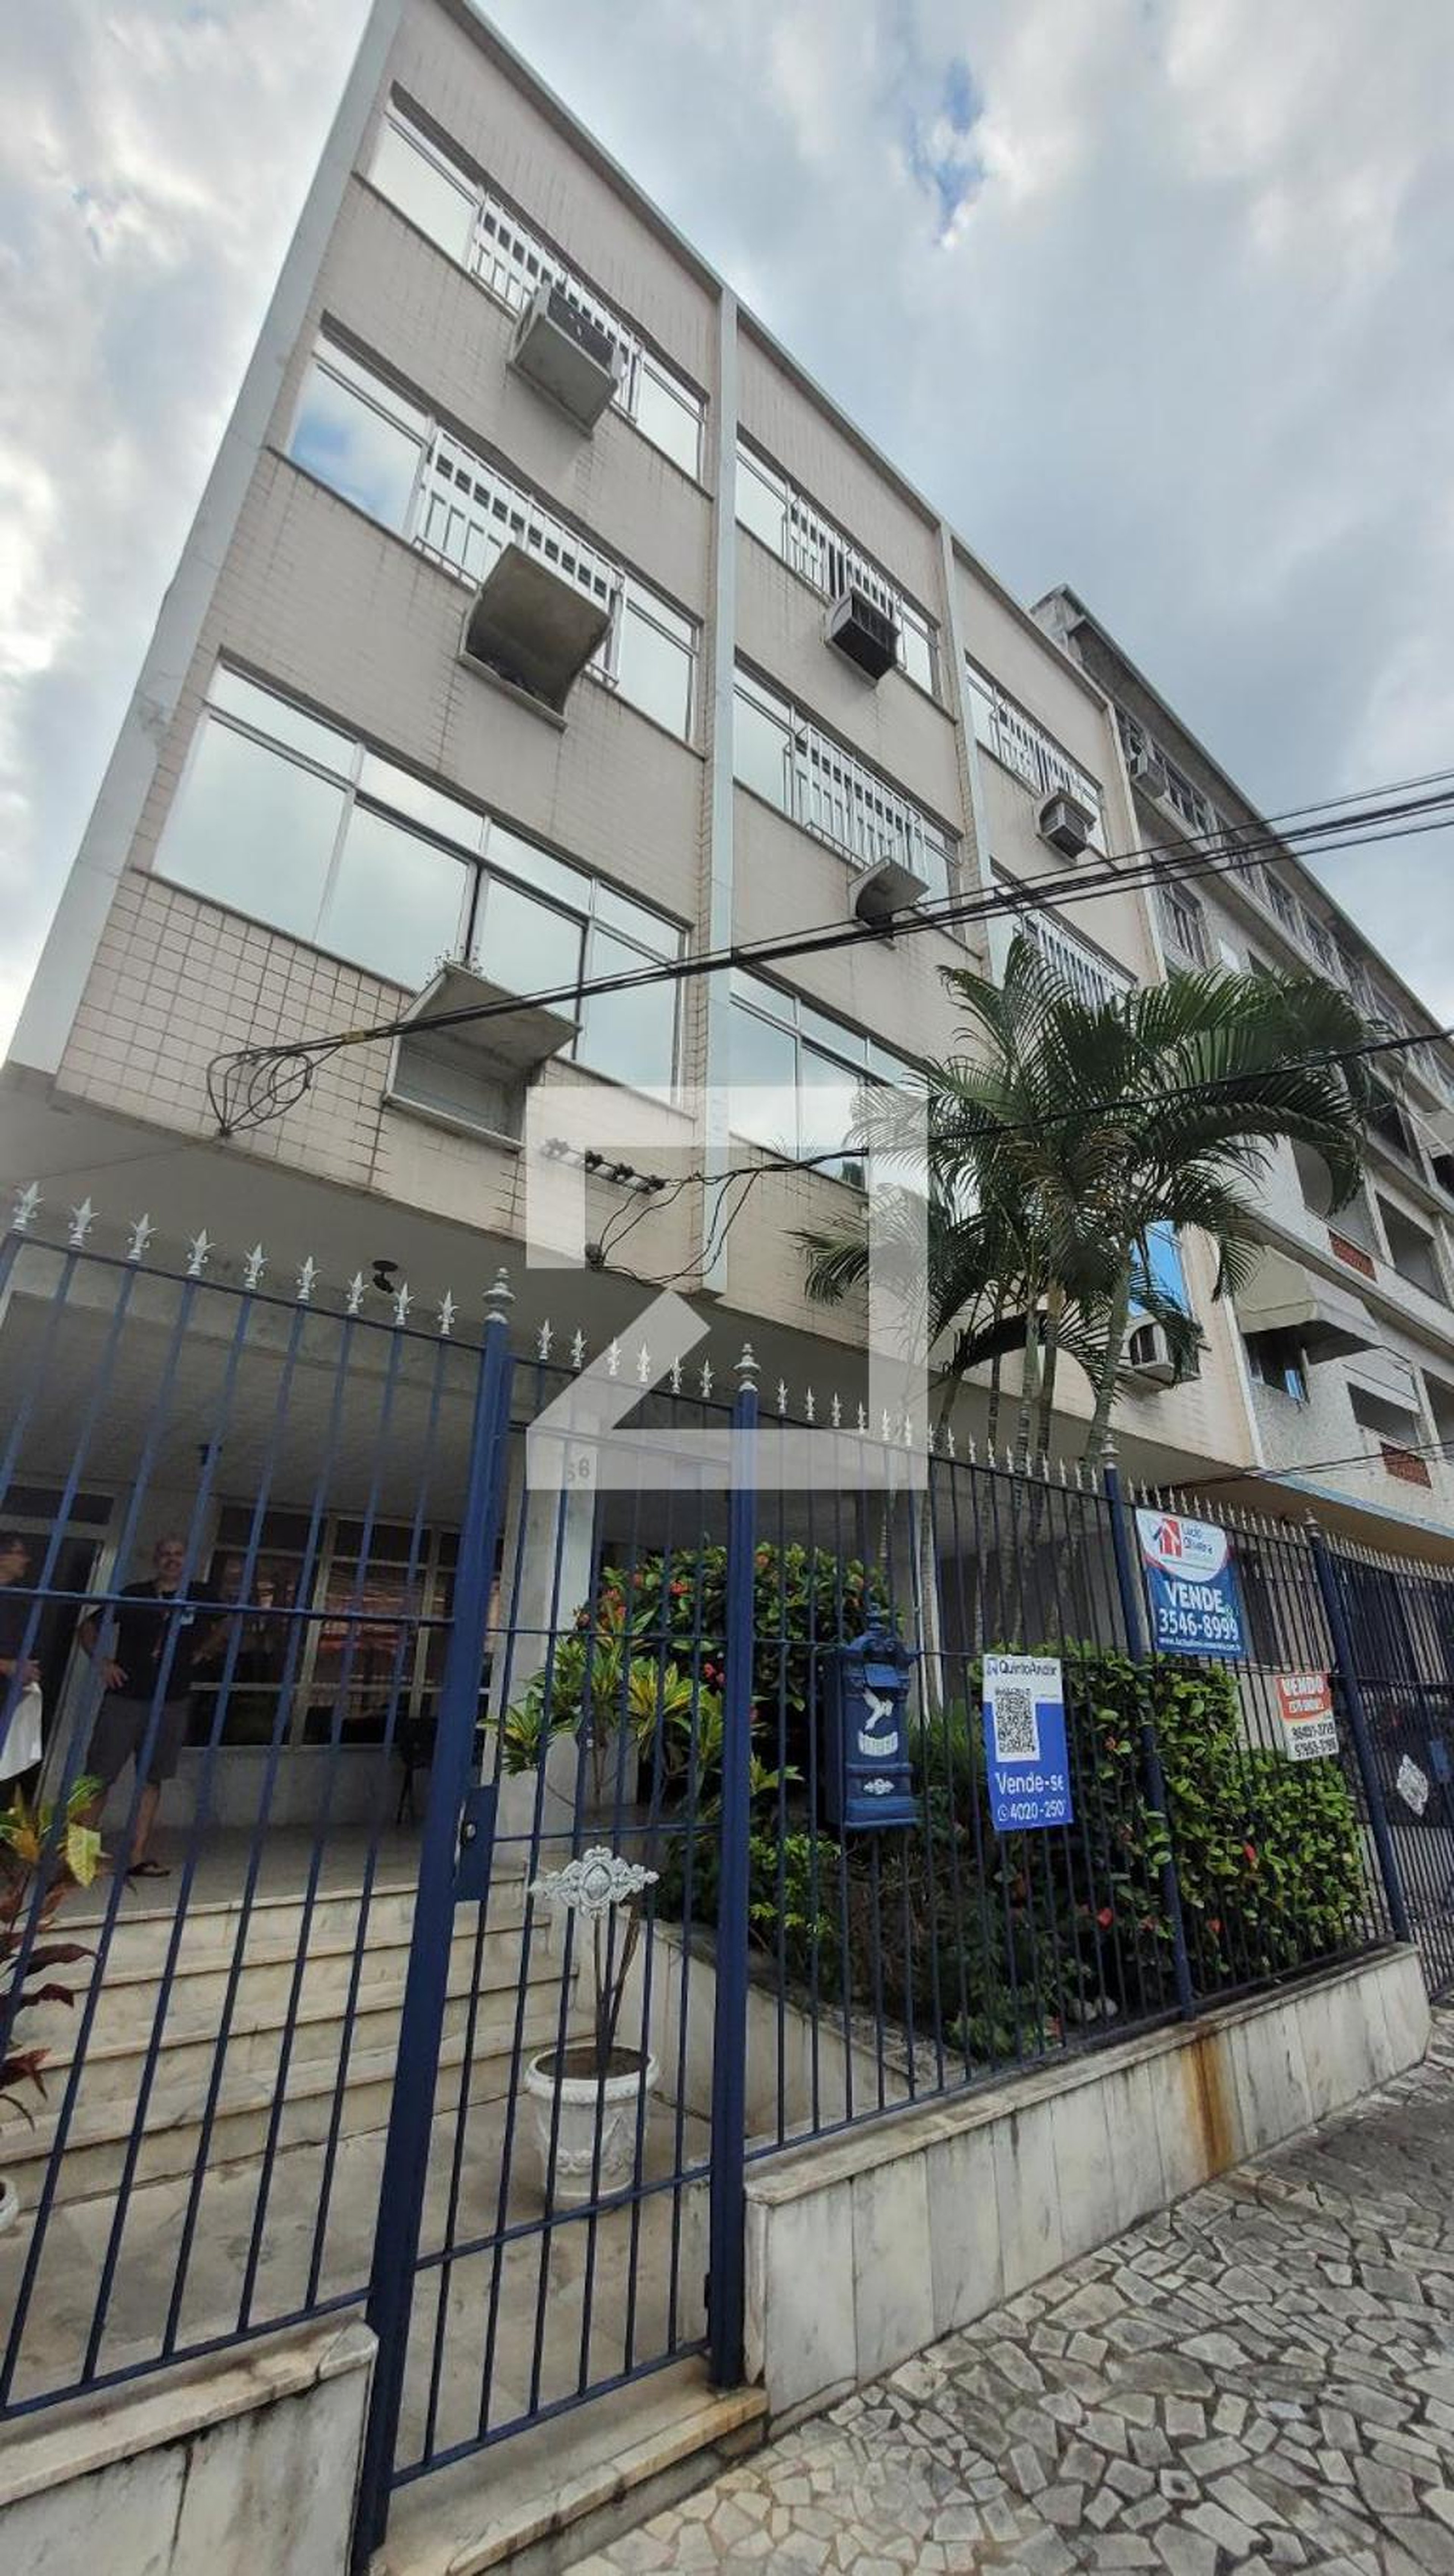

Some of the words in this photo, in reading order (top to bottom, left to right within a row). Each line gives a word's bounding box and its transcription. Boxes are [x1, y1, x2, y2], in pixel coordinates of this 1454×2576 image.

[1164, 1580, 1225, 1613] VENDE
[1159, 1608, 1239, 1641] 3546-8999
[994, 1772, 1064, 1795] Vende-se
